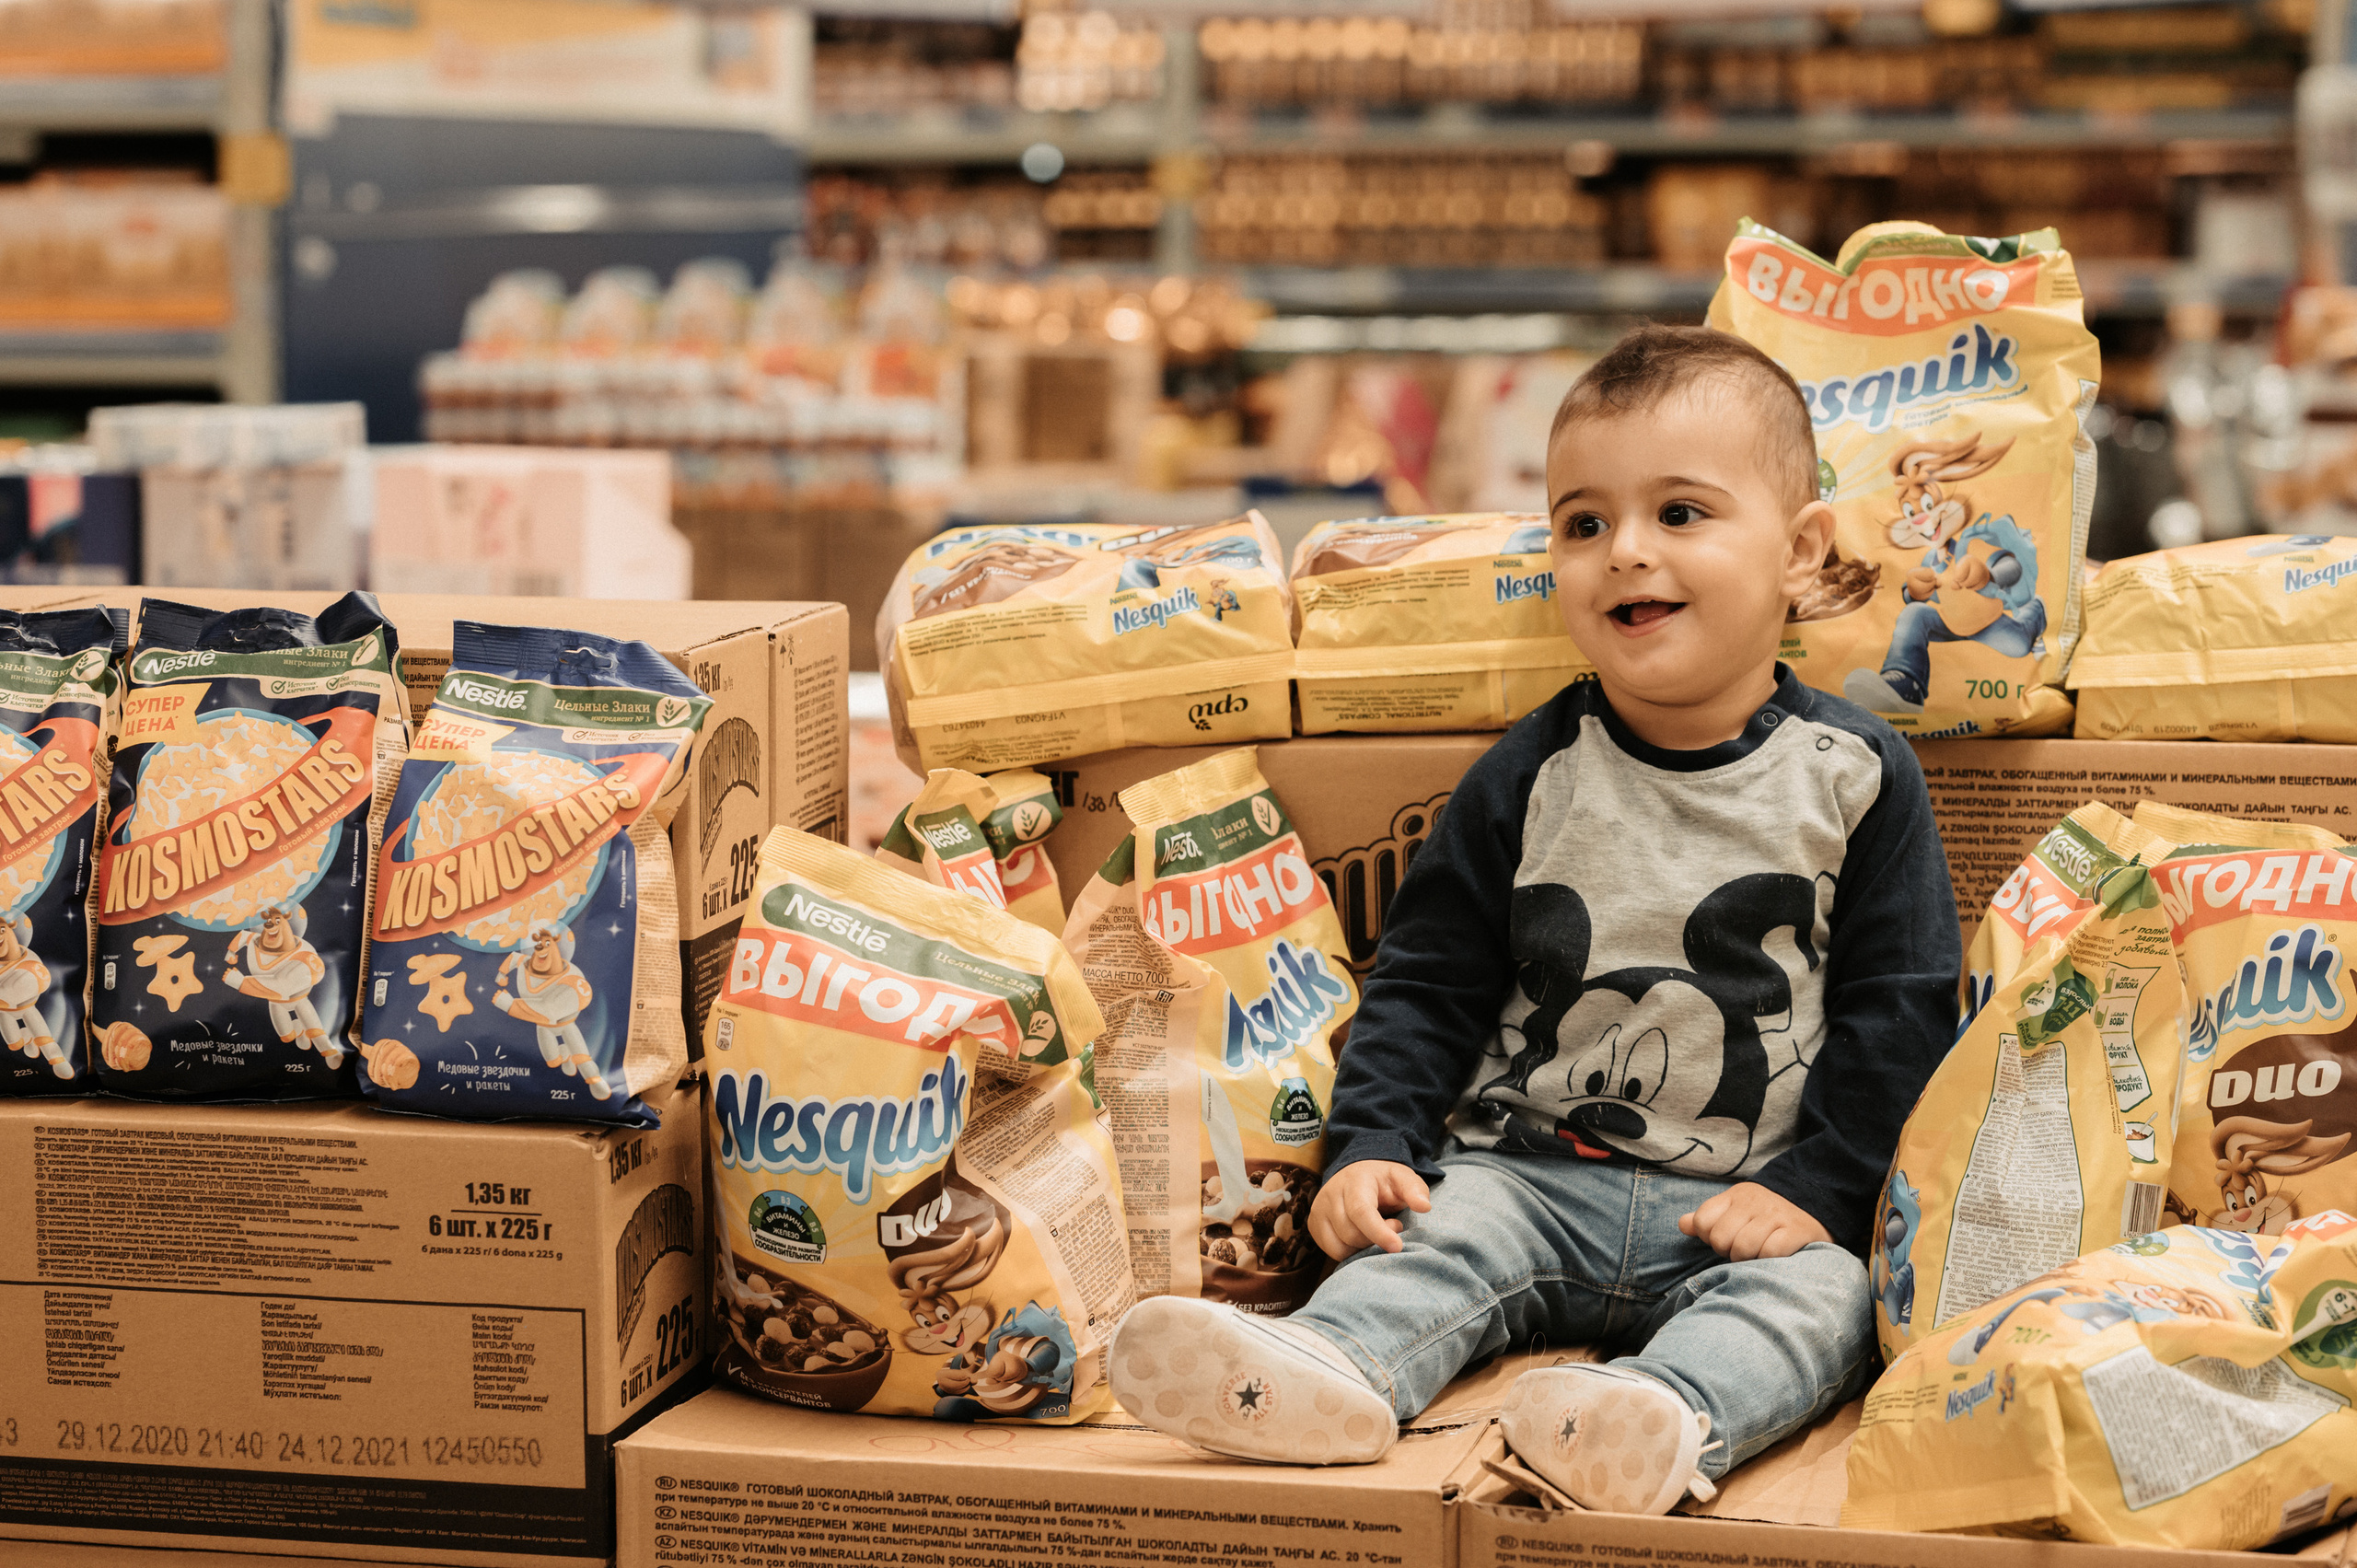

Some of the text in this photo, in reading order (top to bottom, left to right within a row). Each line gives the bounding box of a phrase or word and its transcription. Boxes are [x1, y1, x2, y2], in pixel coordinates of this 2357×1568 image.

[1748, 252, 2009, 325] ВЫГОДНО
[2284, 555, 2357, 594] Nesqui
[1495, 572, 1556, 603] Nesqu
[1112, 587, 1202, 634] Nesquik
[143, 651, 215, 675] Nestlé
[307, 647, 348, 659] Злаки
[445, 679, 528, 710] Nestlé
[1966, 679, 2008, 699] 700
[125, 696, 185, 716] СУПЕР
[553, 699, 650, 714] Цельные Злаки
[420, 718, 485, 738] СУПЕР
[590, 714, 633, 723] ингредиент
[2001, 770, 2087, 781] ОБОГАЩЕННЫЙ
[2091, 772, 2166, 783] ВИТАМИНАМИ
[2171, 773, 2177, 782] И
[2182, 773, 2276, 784] МИНЕРАЛЬНЫМИ
[313, 803, 348, 829] завтрак
[2245, 803, 2285, 815] ДАЙЫН
[40, 813, 72, 838] завтрак
[104, 739, 365, 914] KOSMOSTARS
[3, 838, 39, 863] Готовый
[278, 827, 314, 854] Готовый
[379, 773, 641, 931] KOSMOSTARS
[702, 892, 708, 920] 6
[784, 894, 892, 952] Nestlé
[934, 951, 1003, 981] Цельные
[1083, 968, 1164, 983] МАССА НЕТТО 700
[721, 1021, 731, 1030] 165
[2109, 1017, 2124, 1026] ВОДЫ
[170, 1039, 263, 1054] Медовые звездочки
[212, 1052, 245, 1066] ракеты
[285, 1064, 304, 1073] 225
[438, 1061, 530, 1077] Медовые звездочки
[466, 1079, 511, 1093] и ракеты
[551, 1089, 575, 1099] 225 г
[714, 1051, 970, 1200] Nesquik
[465, 1182, 531, 1205] 1,35 кг
[429, 1215, 442, 1236] 6
[501, 1218, 539, 1240] 225
[543, 1223, 552, 1240] г
[766, 1213, 807, 1233] ВИТАМИНЫ
[773, 1227, 800, 1239] ЖЕЛЕЗО
[422, 1245, 563, 1261] 6 дана 225 6 dona 225 g
[755, 1239, 821, 1261] СООБРАЗИТЕЛЬНОСТИ
[472, 1314, 485, 1322] Код
[1238, 1304, 1253, 1312] БЕЗ
[621, 1295, 693, 1408] 6 225
[751, 1383, 831, 1409] КОНСЕРВАНТОВ
[1223, 1372, 1247, 1414] CONVERSE
[1945, 1370, 1996, 1423] Nesquik
[474, 1400, 500, 1410] Рамзи
[1039, 1404, 1066, 1418] 700
[57, 1420, 541, 1468] 29.12.2020 21:40 24.12.2021 12450550
[656, 1493, 675, 1503] при
[678, 1495, 748, 1507] температуре
[767, 1500, 799, 1510] выше
[801, 1501, 814, 1510] 20
[843, 1504, 927, 1517] относительной
[931, 1511, 992, 1522] влажности
[995, 1514, 1040, 1526] воздуха
[1044, 1516, 1056, 1525] не
[1060, 1516, 1094, 1527] более
[1097, 1518, 1109, 1528] 75
[1112, 1520, 1126, 1530] %.
[747, 1483, 803, 1496] ГОТОВЫЙ
[807, 1487, 894, 1502] ШОКОЛАДНЫЙ
[898, 1493, 952, 1506] ЗАВТРАК,
[956, 1496, 1051, 1512] ОБОГАЩЕННЫЙ
[1055, 1503, 1137, 1517] ВИТАМИНАМИ
[1142, 1508, 1149, 1517] И
[1154, 1508, 1257, 1524] МИНЕРАЛЬНЫМИ
[1260, 1515, 1349, 1530] ВЕЩЕСТВАМИ.
[1353, 1520, 1402, 1534] Хранить
[656, 1522, 1197, 1564] аспайтын температурада және ауаның салыстырмалы 75 аспайтын жерде
[744, 1515, 847, 1529] ДӘРУМЕНДЕРМЕН
[853, 1521, 886, 1532] ЖӘНЕ
[892, 1523, 967, 1538] МИНЕРАЛДЫ
[972, 1528, 1041, 1541] ЗАТТАРМЕН
[1138, 1539, 1217, 1553] ШОКОЛАДТЫ
[1223, 1543, 1267, 1556] ДАЙЫН
[1346, 1551, 1359, 1562] 20
[712, 1553, 724, 1562] 75
[810, 1547, 898, 1562] MİNERALLARLA
